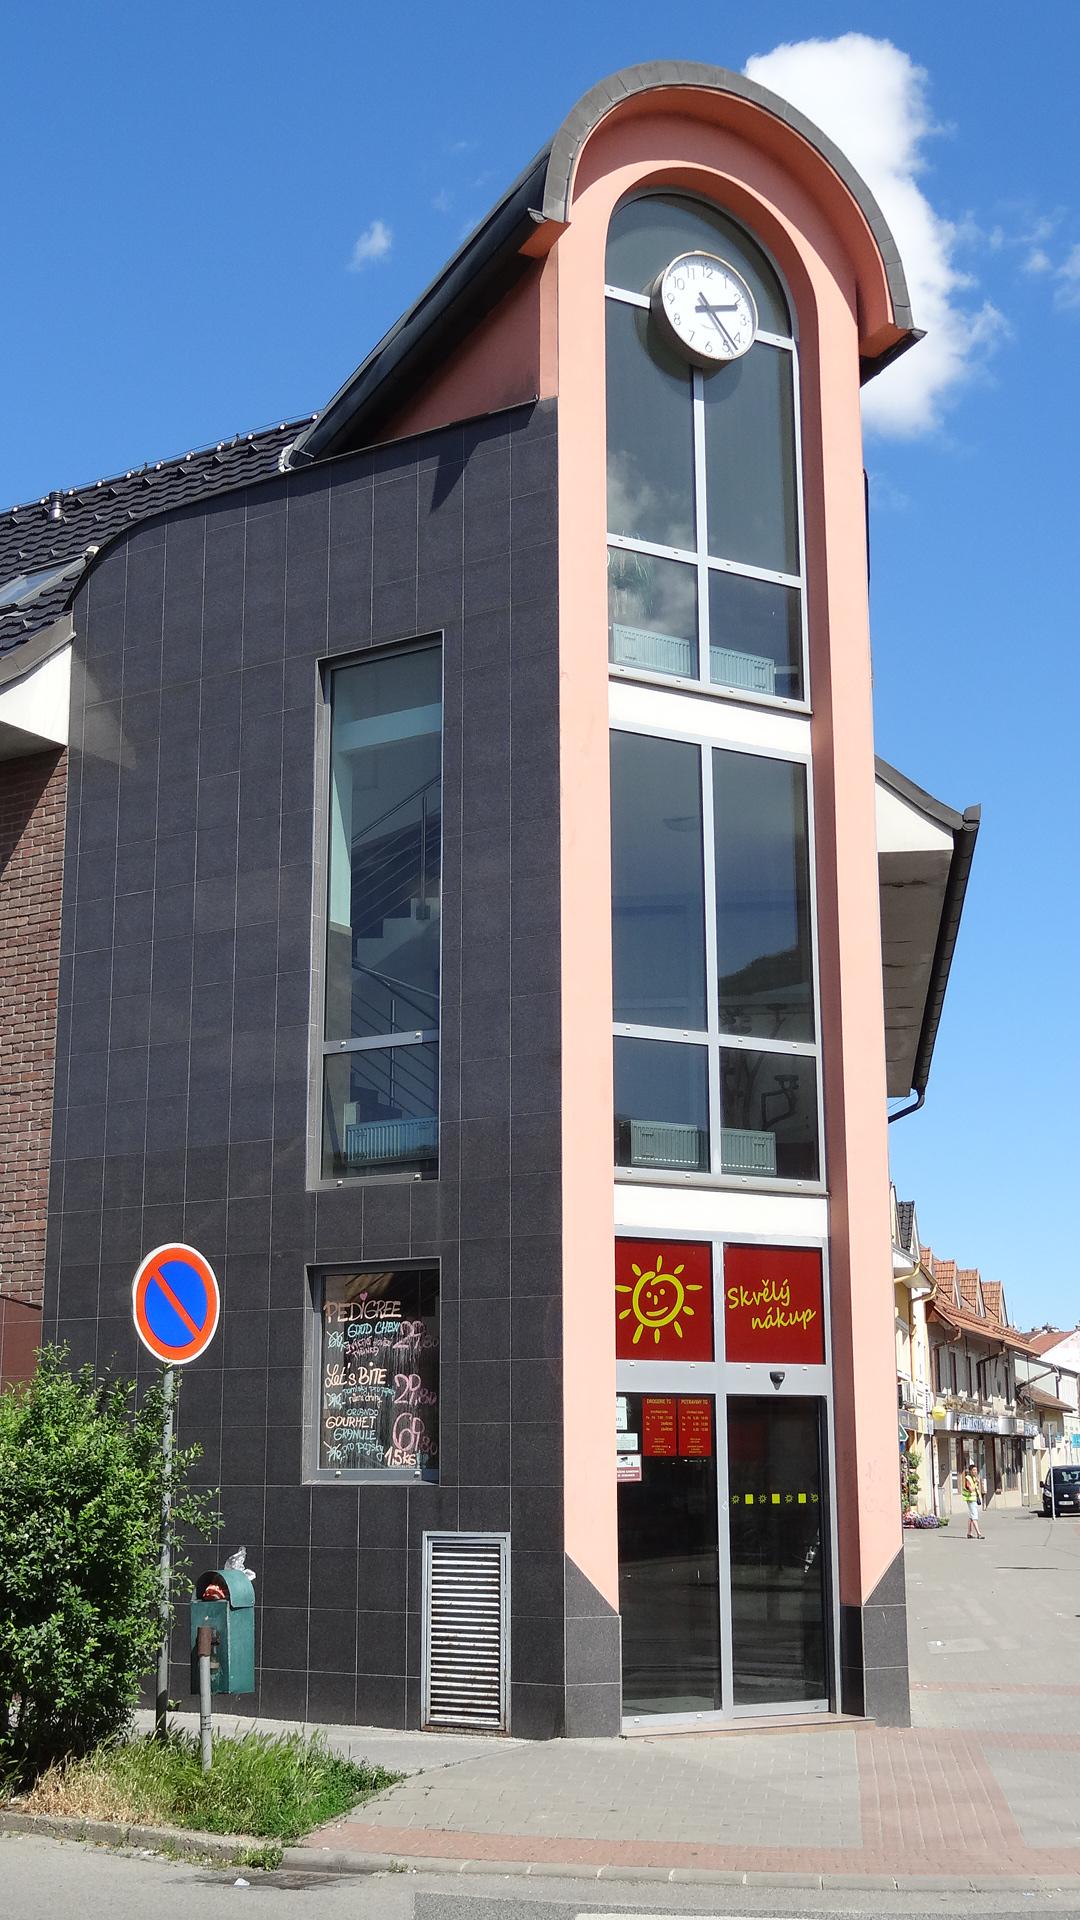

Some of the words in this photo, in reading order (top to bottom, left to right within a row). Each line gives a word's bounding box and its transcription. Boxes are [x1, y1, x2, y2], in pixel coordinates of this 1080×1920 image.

[686, 267, 695, 280] 11
[701, 265, 713, 281] 12
[673, 276, 685, 291] 10
[666, 292, 675, 305] 9
[733, 293, 741, 307] 2
[674, 313, 681, 326] 8
[740, 314, 747, 327] 3
[689, 330, 695, 342] 7
[734, 332, 741, 343] 4
[705, 341, 712, 353] 6
[722, 340, 730, 353] 5
[727, 1278, 791, 1310] Skvělý
[323, 1300, 402, 1323] PEDIGREE
[751, 1306, 817, 1330] nákup
